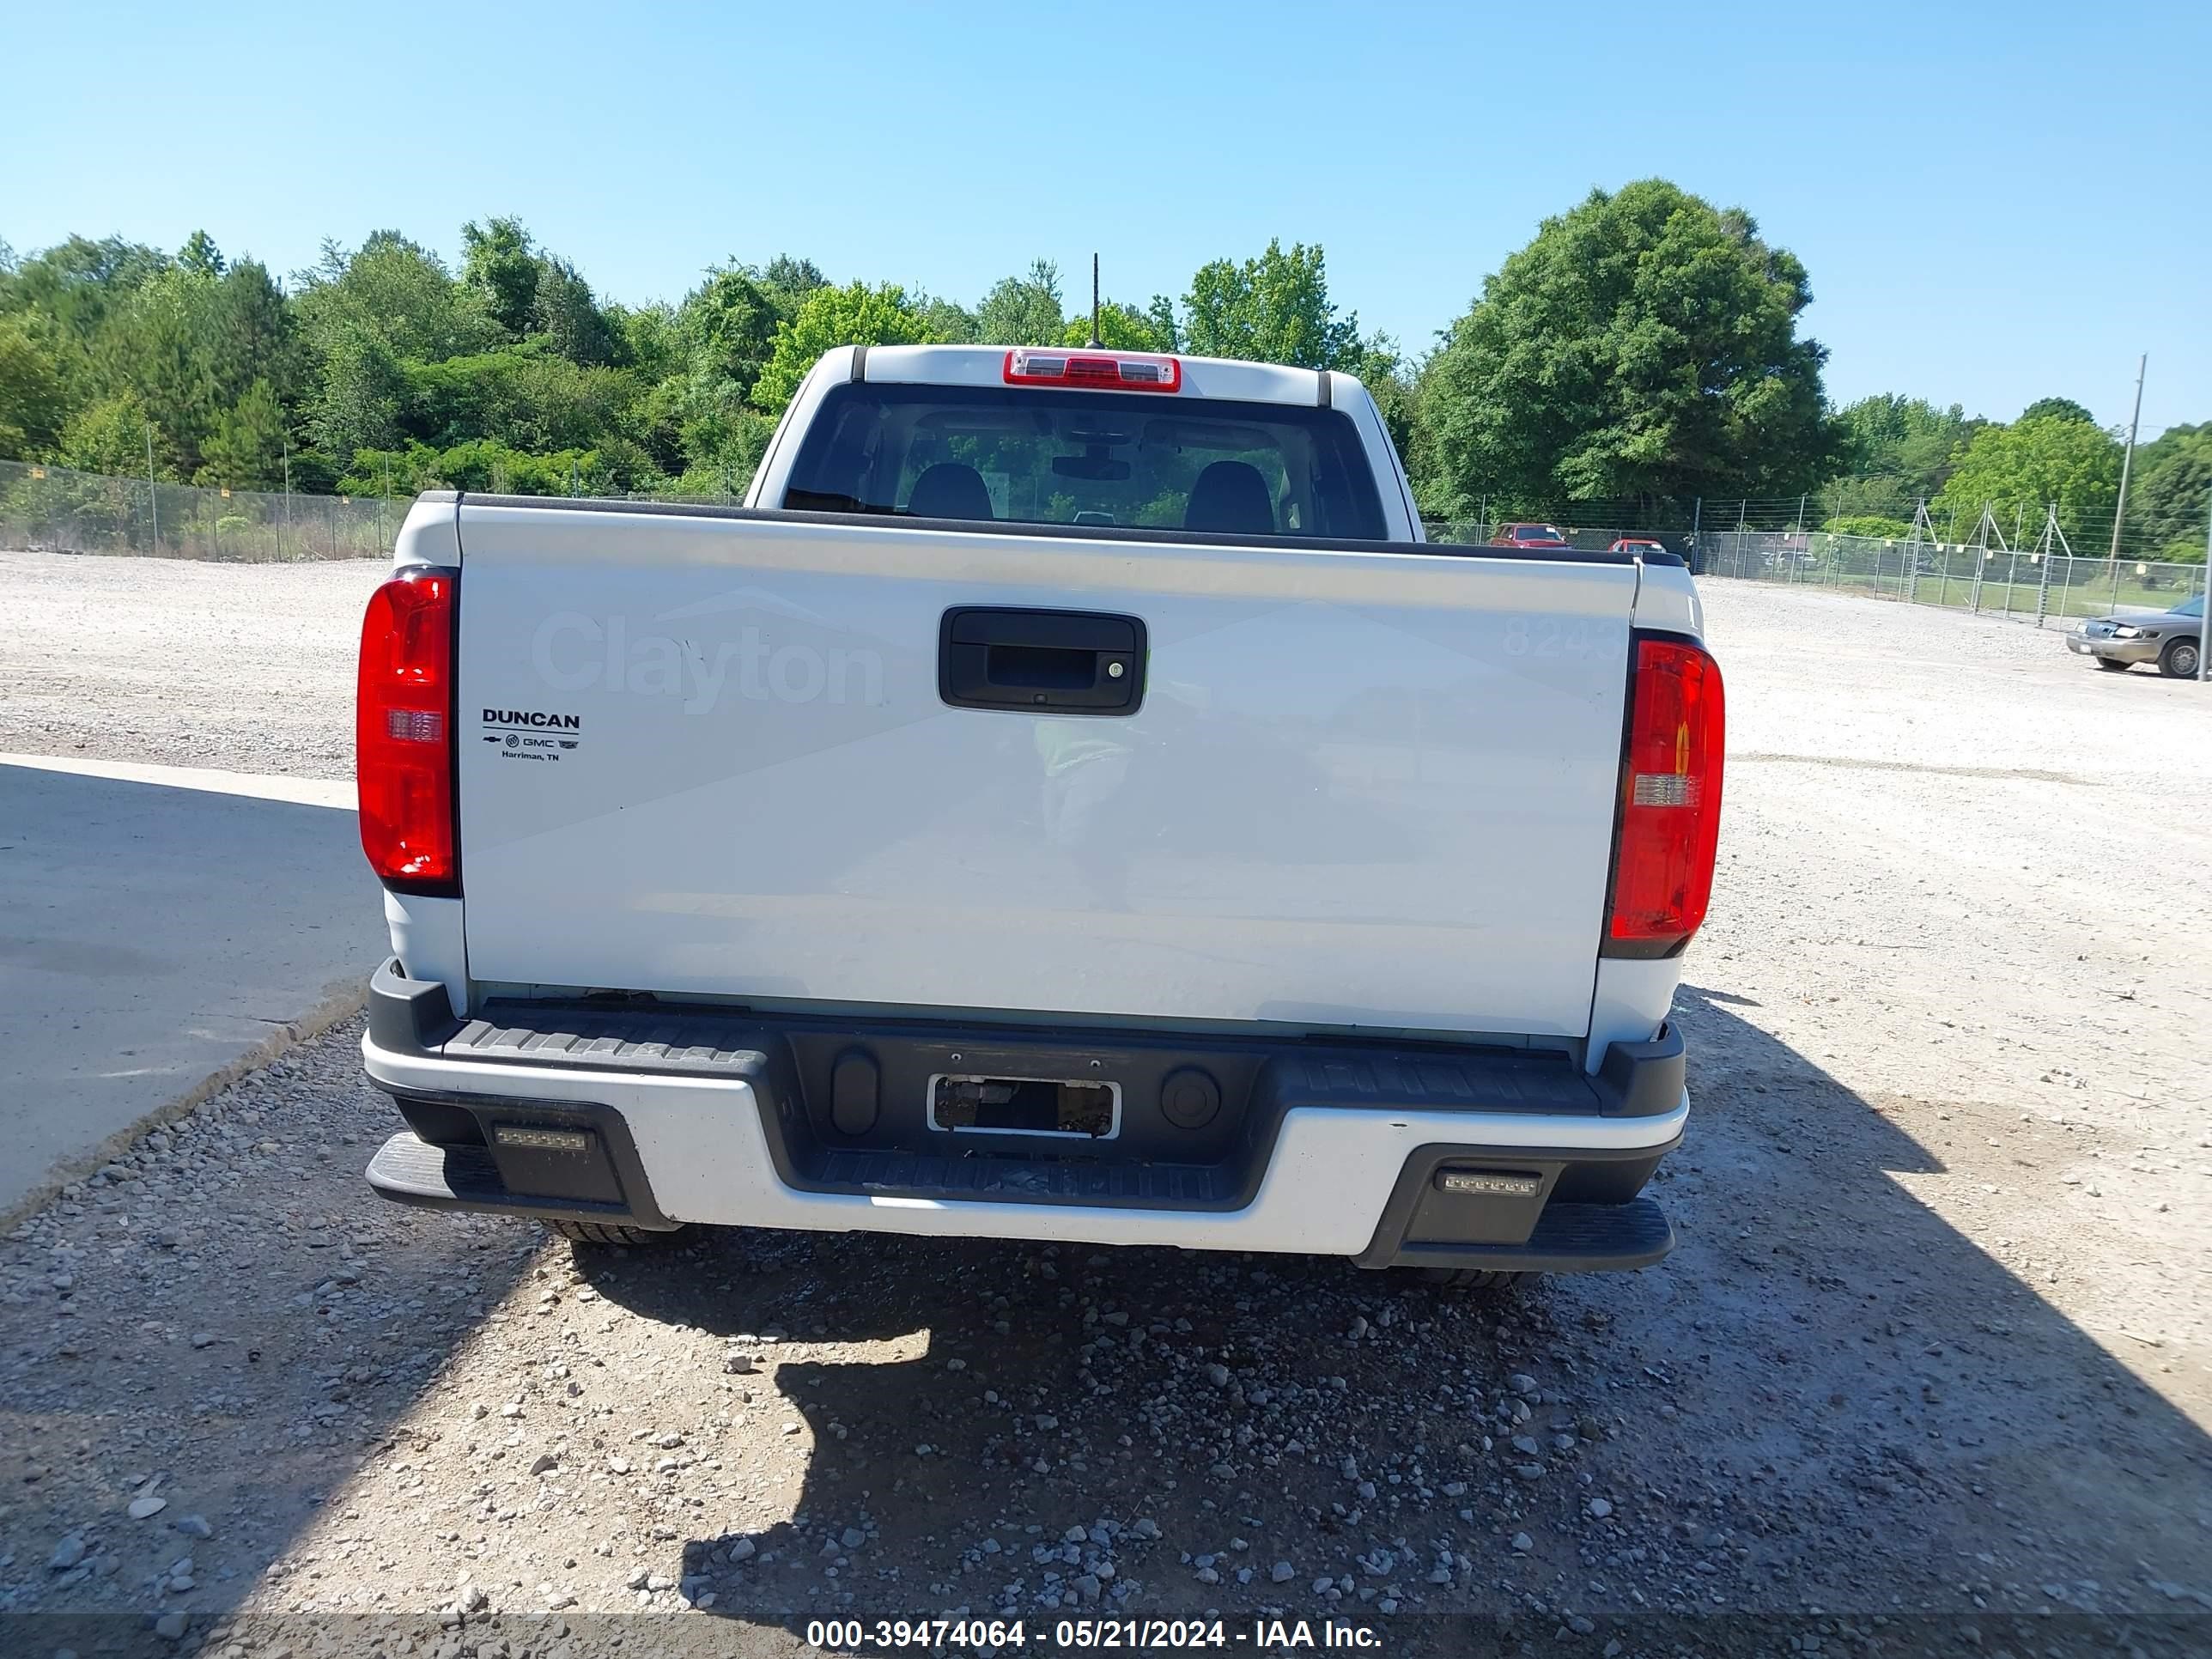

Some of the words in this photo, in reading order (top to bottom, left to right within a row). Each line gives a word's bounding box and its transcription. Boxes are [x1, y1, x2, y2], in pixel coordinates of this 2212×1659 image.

[531, 610, 884, 715] Clayton
[482, 708, 580, 729] DUNCAN
[523, 738, 555, 748] GMC
[501, 750, 544, 761] Harriman,
[547, 753, 559, 762] TN
